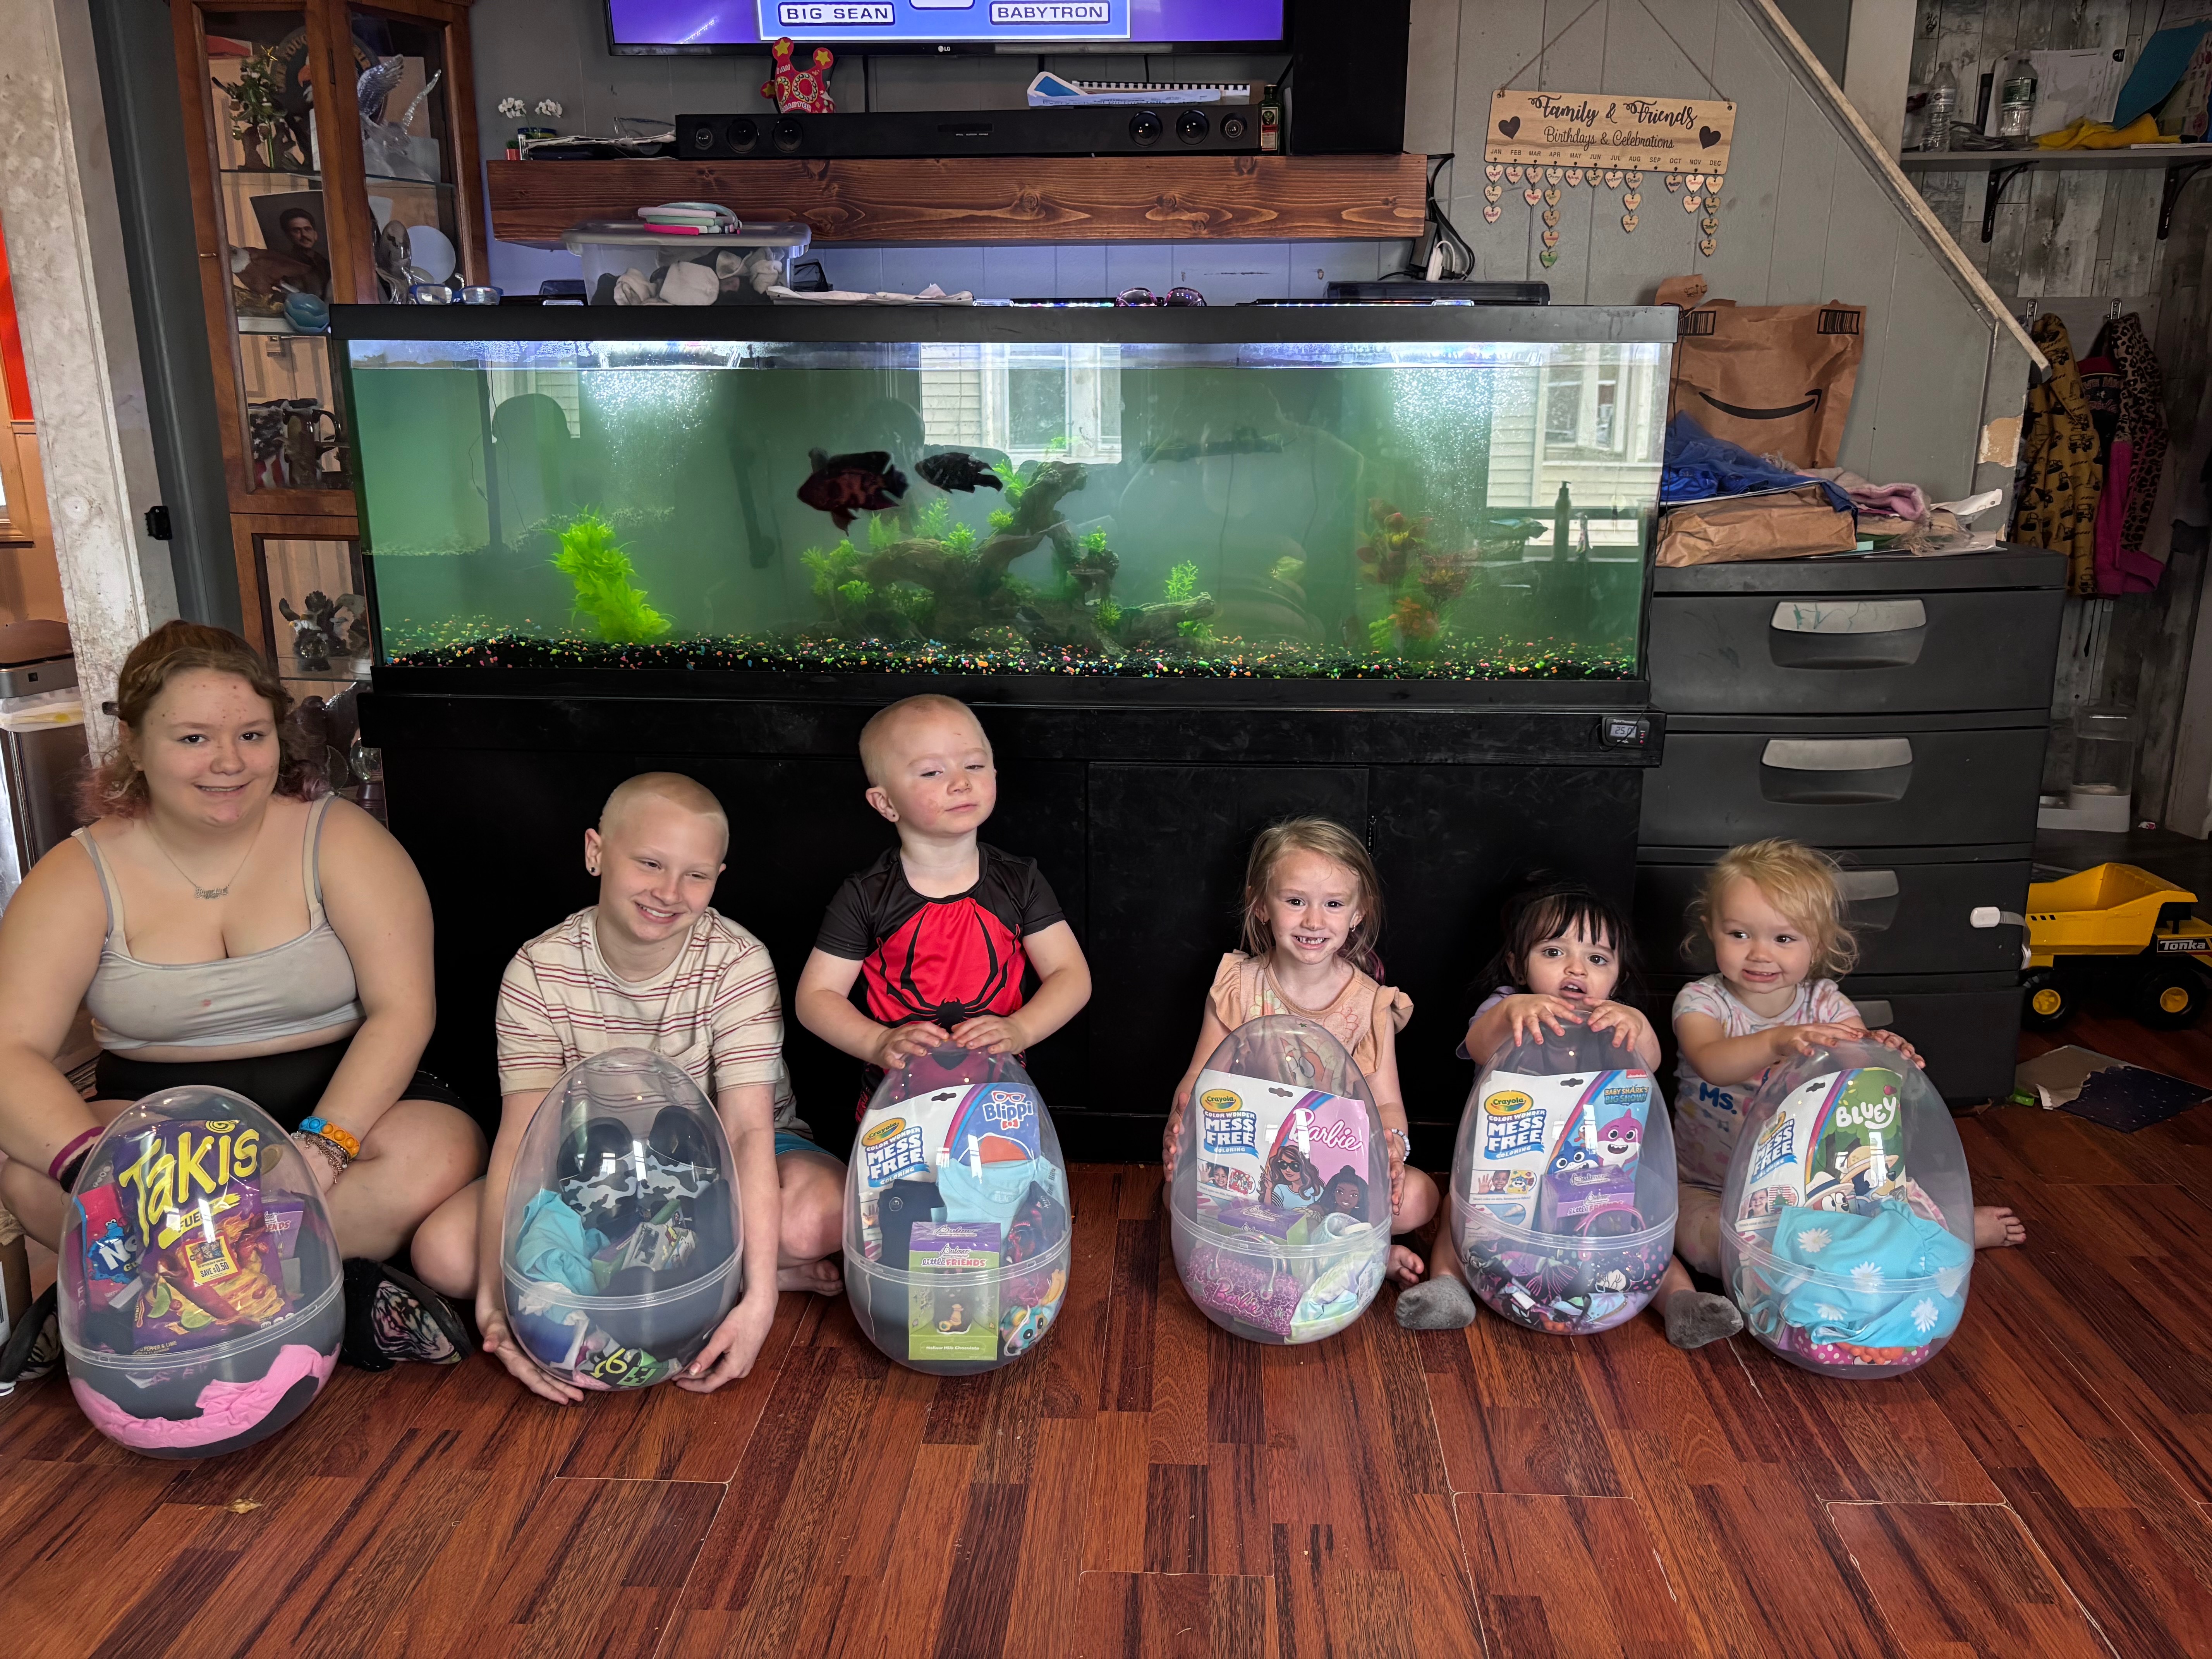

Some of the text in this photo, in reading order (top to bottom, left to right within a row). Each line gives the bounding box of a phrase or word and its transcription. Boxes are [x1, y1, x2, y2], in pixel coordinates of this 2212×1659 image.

[787, 8, 888, 19] BIG SEAN
[998, 6, 1102, 18] BABYTRON
[1528, 95, 1698, 130] Family & Friends
[1544, 126, 1675, 151] Birthdays & Celebrations
[2160, 939, 2206, 950] Tonka
[1605, 1093, 1647, 1103] BIG SHOW!
[1622, 1086, 1649, 1094] SHARK'S
[982, 1101, 1034, 1121] Blippi
[1514, 1110, 1545, 1120] WONDER
[1836, 1096, 1897, 1130] BLUEY
[869, 1122, 897, 1138] Crayola
[1205, 1118, 1254, 1132] MESS
[1289, 1108, 1363, 1151] Barbie
[1488, 1116, 1544, 1136] MESS
[866, 1127, 921, 1152] COLOR WONDER
[1206, 1131, 1254, 1147] FREE
[1488, 1130, 1542, 1152] FREE
[1755, 1126, 1793, 1163] MESS
[867, 1133, 921, 1166] MESS
[1496, 1146, 1531, 1159] COLORING
[1753, 1140, 1793, 1176] FREE
[870, 1148, 923, 1179] FREE
[880, 1166, 915, 1185] COLORING
[200, 1268, 213, 1278] SAVE
[213, 1262, 230, 1273] $0.50
[921, 1258, 986, 1267] little FRIENDS
